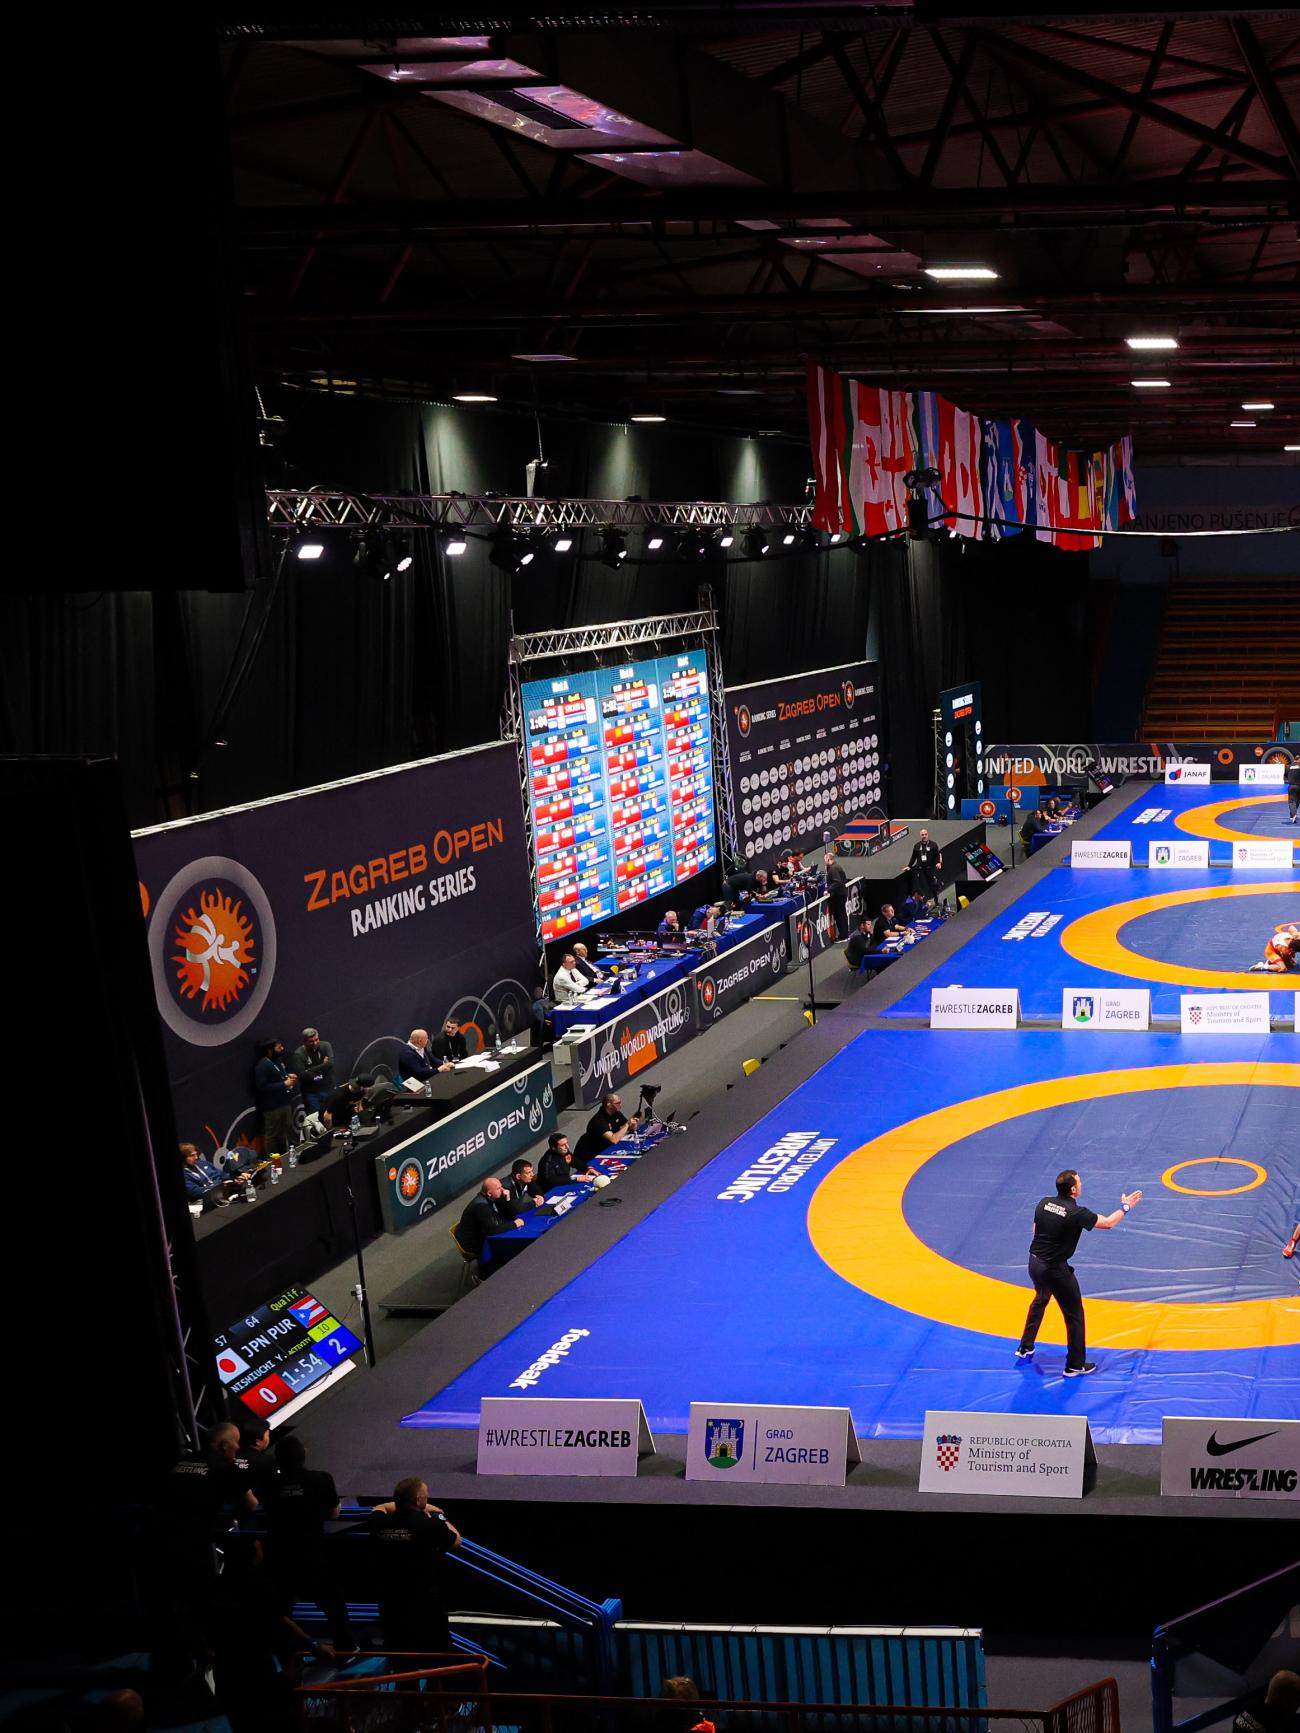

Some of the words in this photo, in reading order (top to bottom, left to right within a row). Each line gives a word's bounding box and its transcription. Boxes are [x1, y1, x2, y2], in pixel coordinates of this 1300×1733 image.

[1123, 513, 1204, 530] ANJENO
[1210, 511, 1287, 529] PUŠENJE
[778, 699, 816, 721] ZAGREB
[816, 692, 841, 711] OPEN
[1184, 770, 1207, 778] JANAF
[304, 843, 429, 912] ZAGREB
[433, 818, 504, 865] OPEN
[1074, 851, 1128, 859] #WRESTLEZAGREB
[351, 885, 426, 937] RANKING
[429, 865, 477, 906] SERIES
[717, 966, 749, 995] ZAGREB
[750, 953, 771, 975] OPEN
[935, 1003, 1013, 1014] #WRESTLEZAGREB
[1105, 1010, 1140, 1019] ZAGREB
[593, 1050, 620, 1078] UNITED
[620, 1034, 646, 1061] WORLD
[646, 1009, 684, 1044] WRESTLING
[426, 1131, 486, 1180] ZAGREB
[487, 1106, 525, 1140] OPEN
[797, 1138, 839, 1163] UNITED
[716, 1131, 820, 1203] WRESTLING
[767, 1164, 813, 1193] WORLD
[214, 1335, 228, 1347] 57
[246, 1316, 261, 1328] 64
[270, 1288, 304, 1312] Qualif.
[317, 1323, 330, 1334] 10
[241, 1334, 271, 1358] JPN
[267, 1317, 297, 1340] PUR
[288, 1337, 312, 1355] ACTIVITY
[258, 1387, 278, 1404] 0
[282, 1352, 323, 1386] 1:54
[328, 1338, 347, 1355] 2
[508, 1328, 590, 1390] foeldeak
[231, 1360, 276, 1393] NISHIUCHI
[274, 1352, 288, 1363] Y.
[486, 1429, 631, 1448] #WRESTLEZAGREB
[766, 1429, 793, 1439] GRAD
[970, 1436, 1015, 1446] REPUBLIC
[1016, 1438, 1029, 1447] OF
[1031, 1438, 1072, 1448] CROATIA
[765, 1447, 829, 1464] ZAGREB
[969, 1448, 1016, 1462] Ministry
[1018, 1449, 1032, 1460] of
[968, 1461, 1013, 1472] Tourism
[1016, 1462, 1036, 1473] and
[1039, 1463, 1069, 1476] Sport
[1190, 1466, 1298, 1492] WRESTLING
